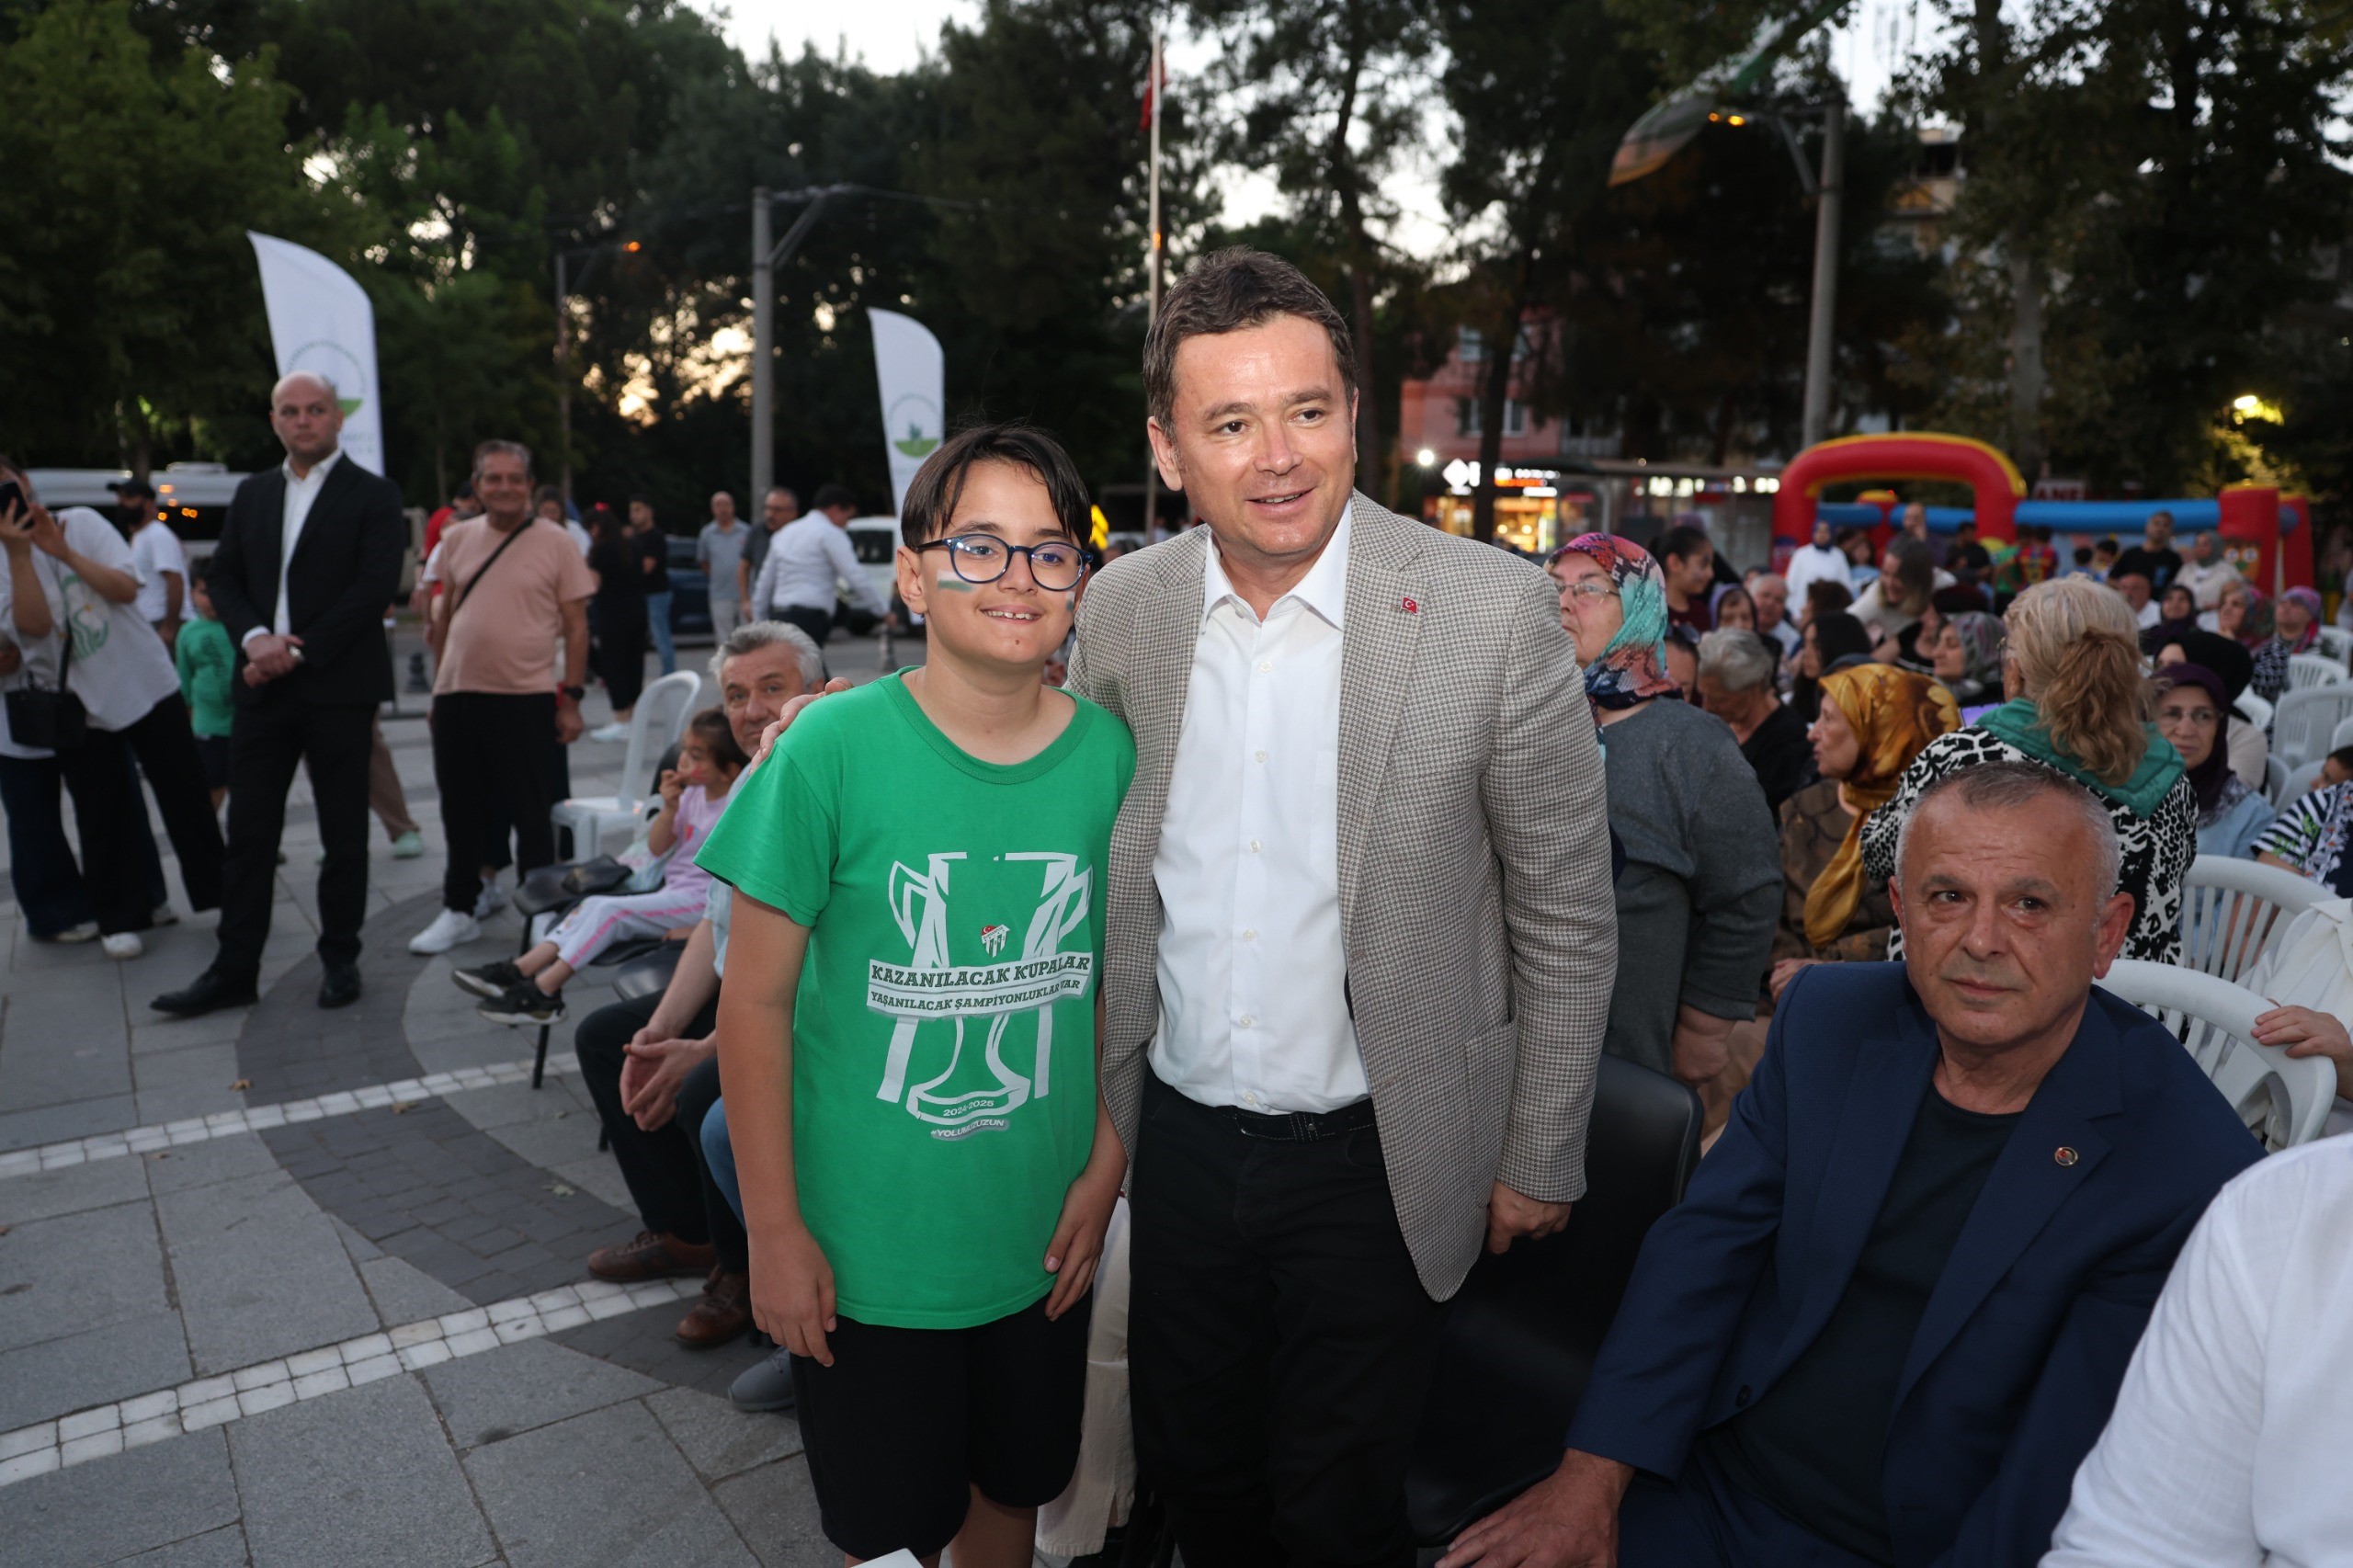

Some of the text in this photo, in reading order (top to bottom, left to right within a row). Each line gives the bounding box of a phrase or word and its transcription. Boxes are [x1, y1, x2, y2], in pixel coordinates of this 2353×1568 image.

[871, 955, 1091, 988] KAZANILACAK KUPALAR
[870, 979, 1081, 1011] YAŞANILACAK ŞAMPİYONLUKLAR VAR
[942, 1099, 995, 1117] 2024-2025
